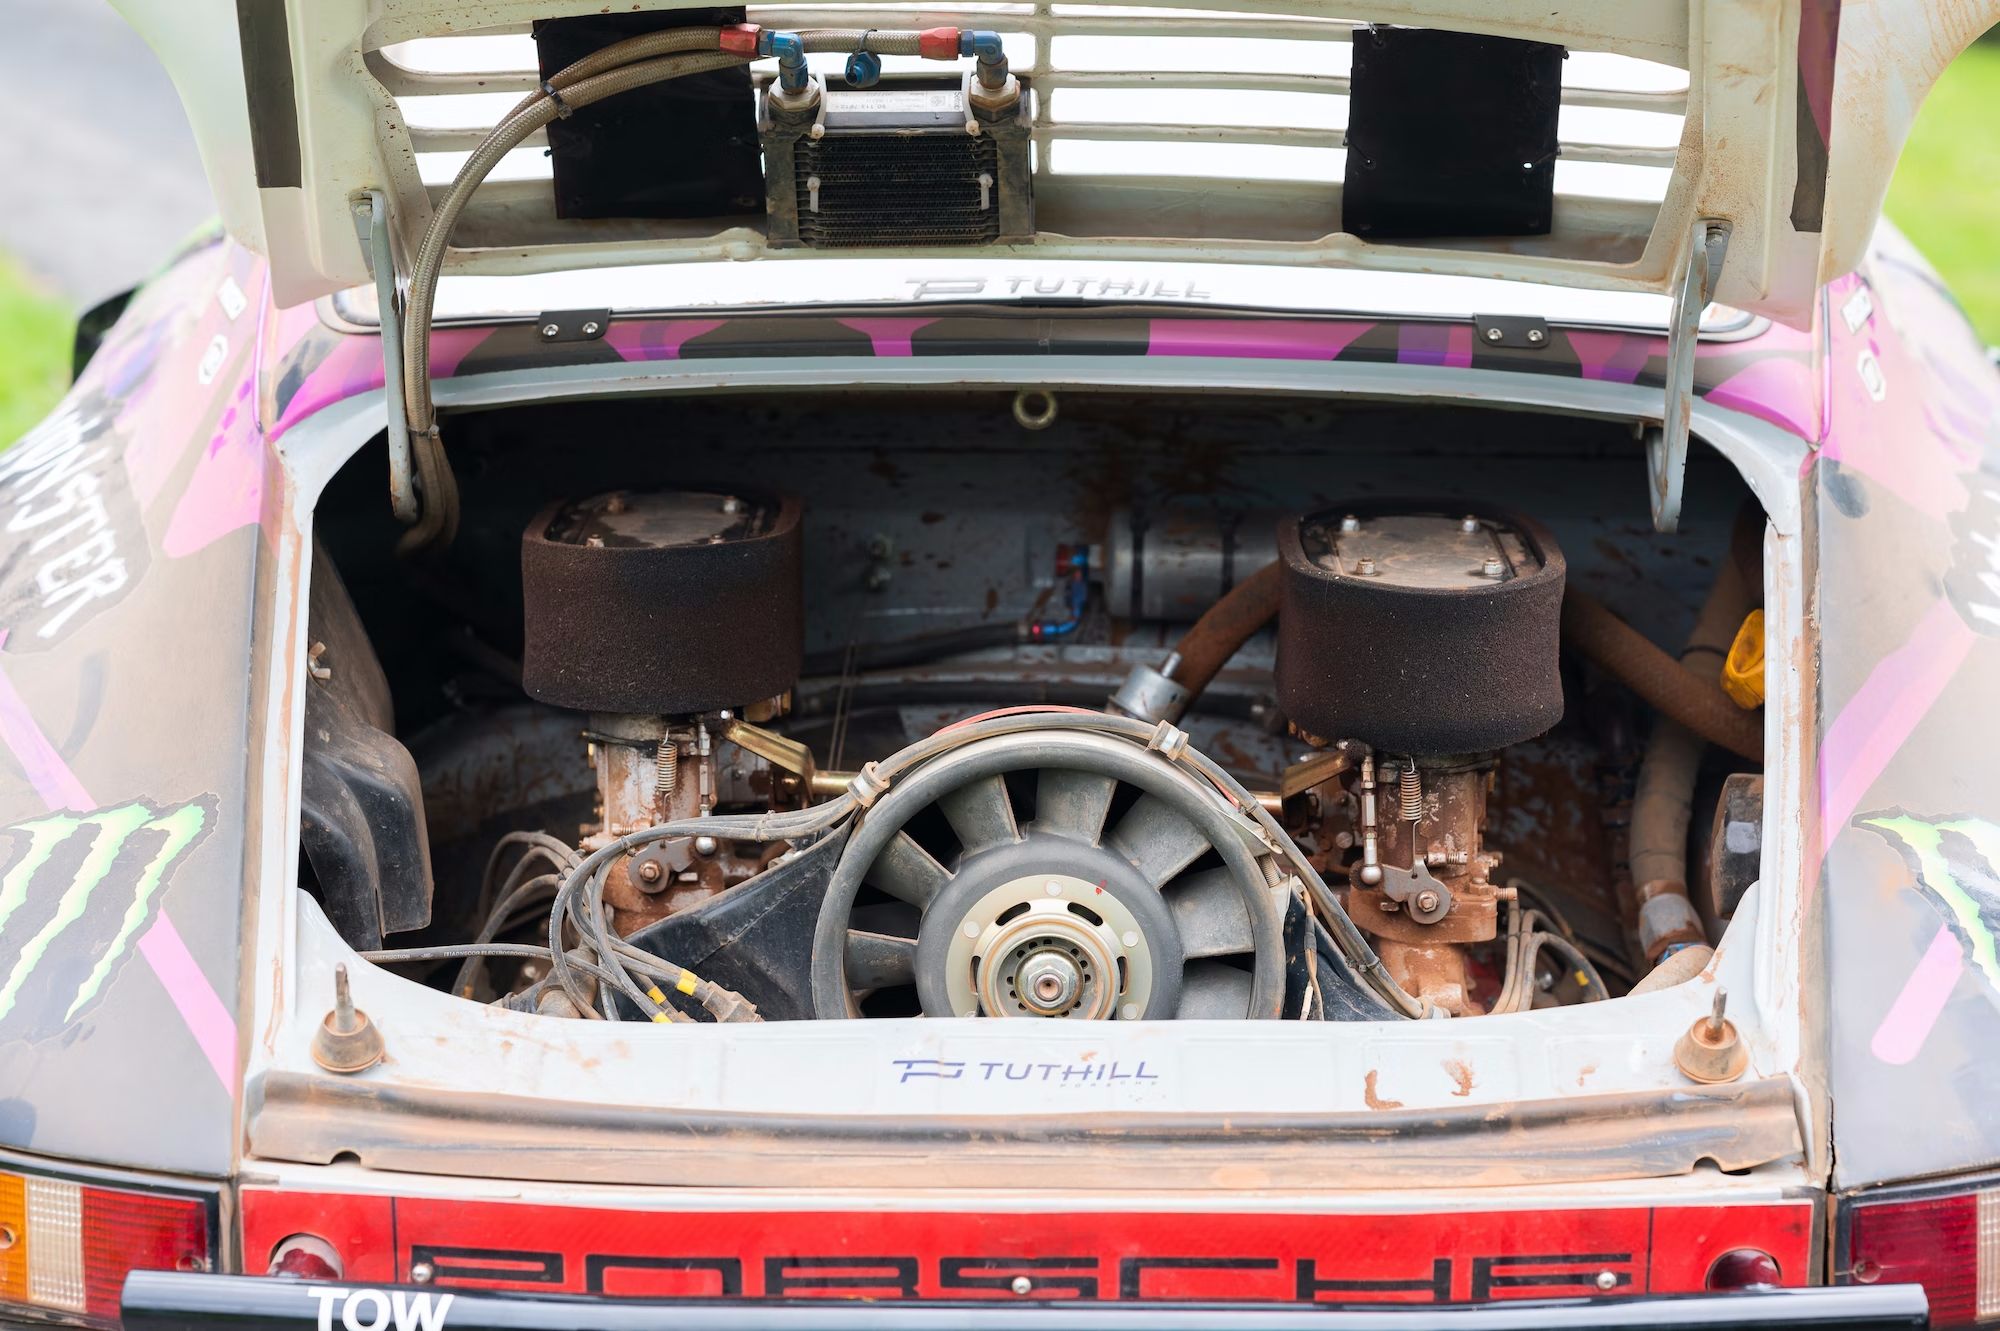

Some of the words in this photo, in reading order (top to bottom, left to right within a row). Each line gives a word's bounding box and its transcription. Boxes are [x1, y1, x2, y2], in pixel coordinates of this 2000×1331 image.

[1005, 276, 1211, 299] TUTHILL
[979, 1060, 1159, 1081] TUTHILL
[411, 1245, 1632, 1300] PORSCHE
[307, 1286, 456, 1331] TOW
